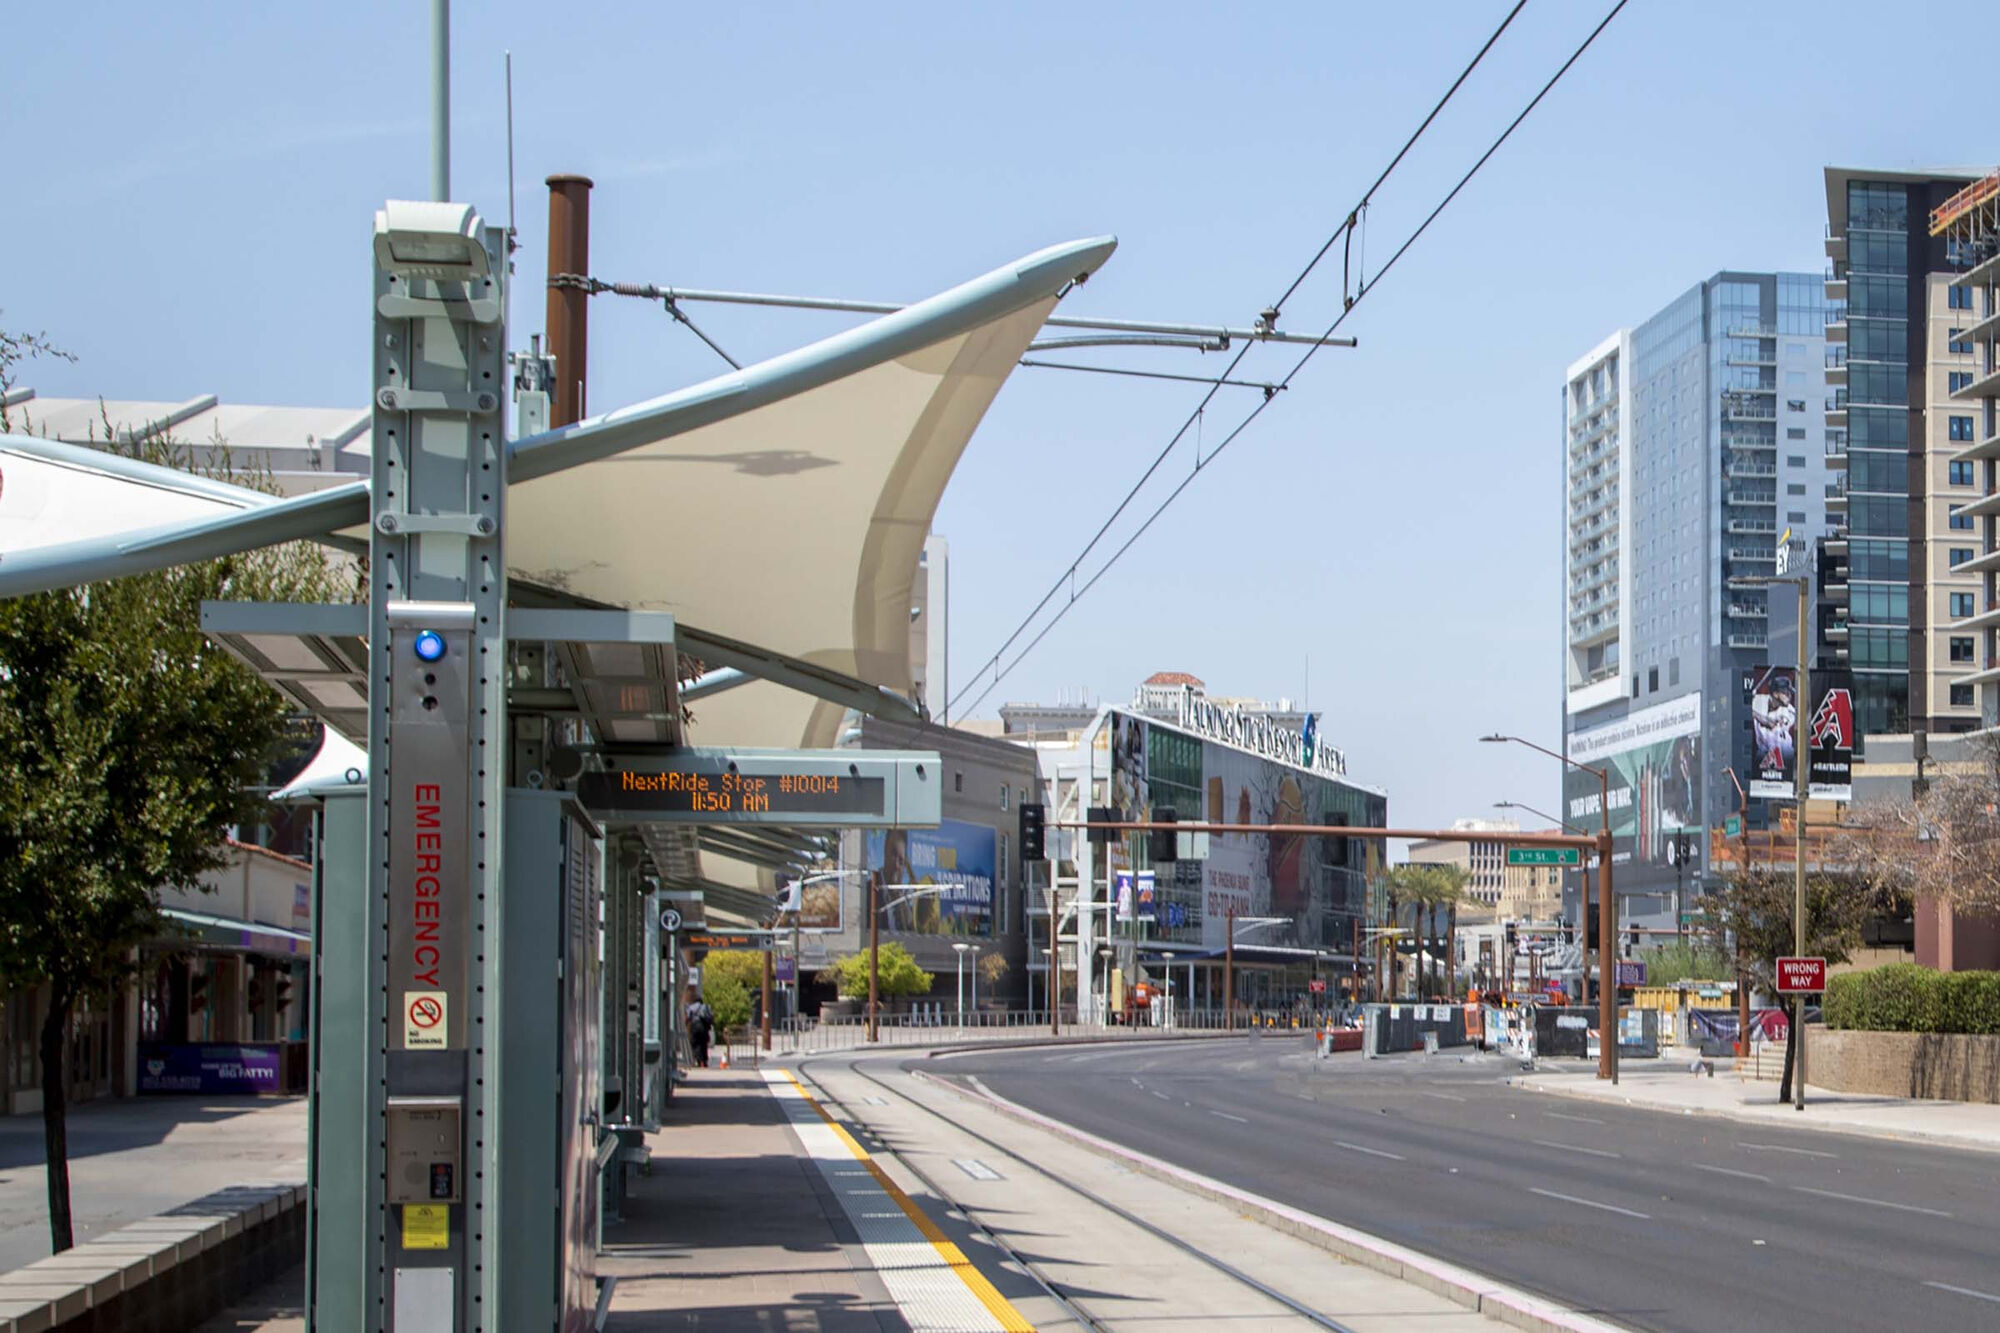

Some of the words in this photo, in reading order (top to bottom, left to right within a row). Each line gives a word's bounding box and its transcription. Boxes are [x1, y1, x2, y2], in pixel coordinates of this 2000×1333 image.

[1776, 545, 1790, 576] EY
[622, 771, 708, 792] NextRide
[721, 773, 767, 793] Stop
[779, 774, 840, 793] #10014
[692, 792, 731, 812] 11:50
[743, 793, 769, 812] AM
[413, 784, 441, 988] EMERGENCY
[1783, 962, 1820, 975] WRONG
[1790, 975, 1812, 987] WAY
